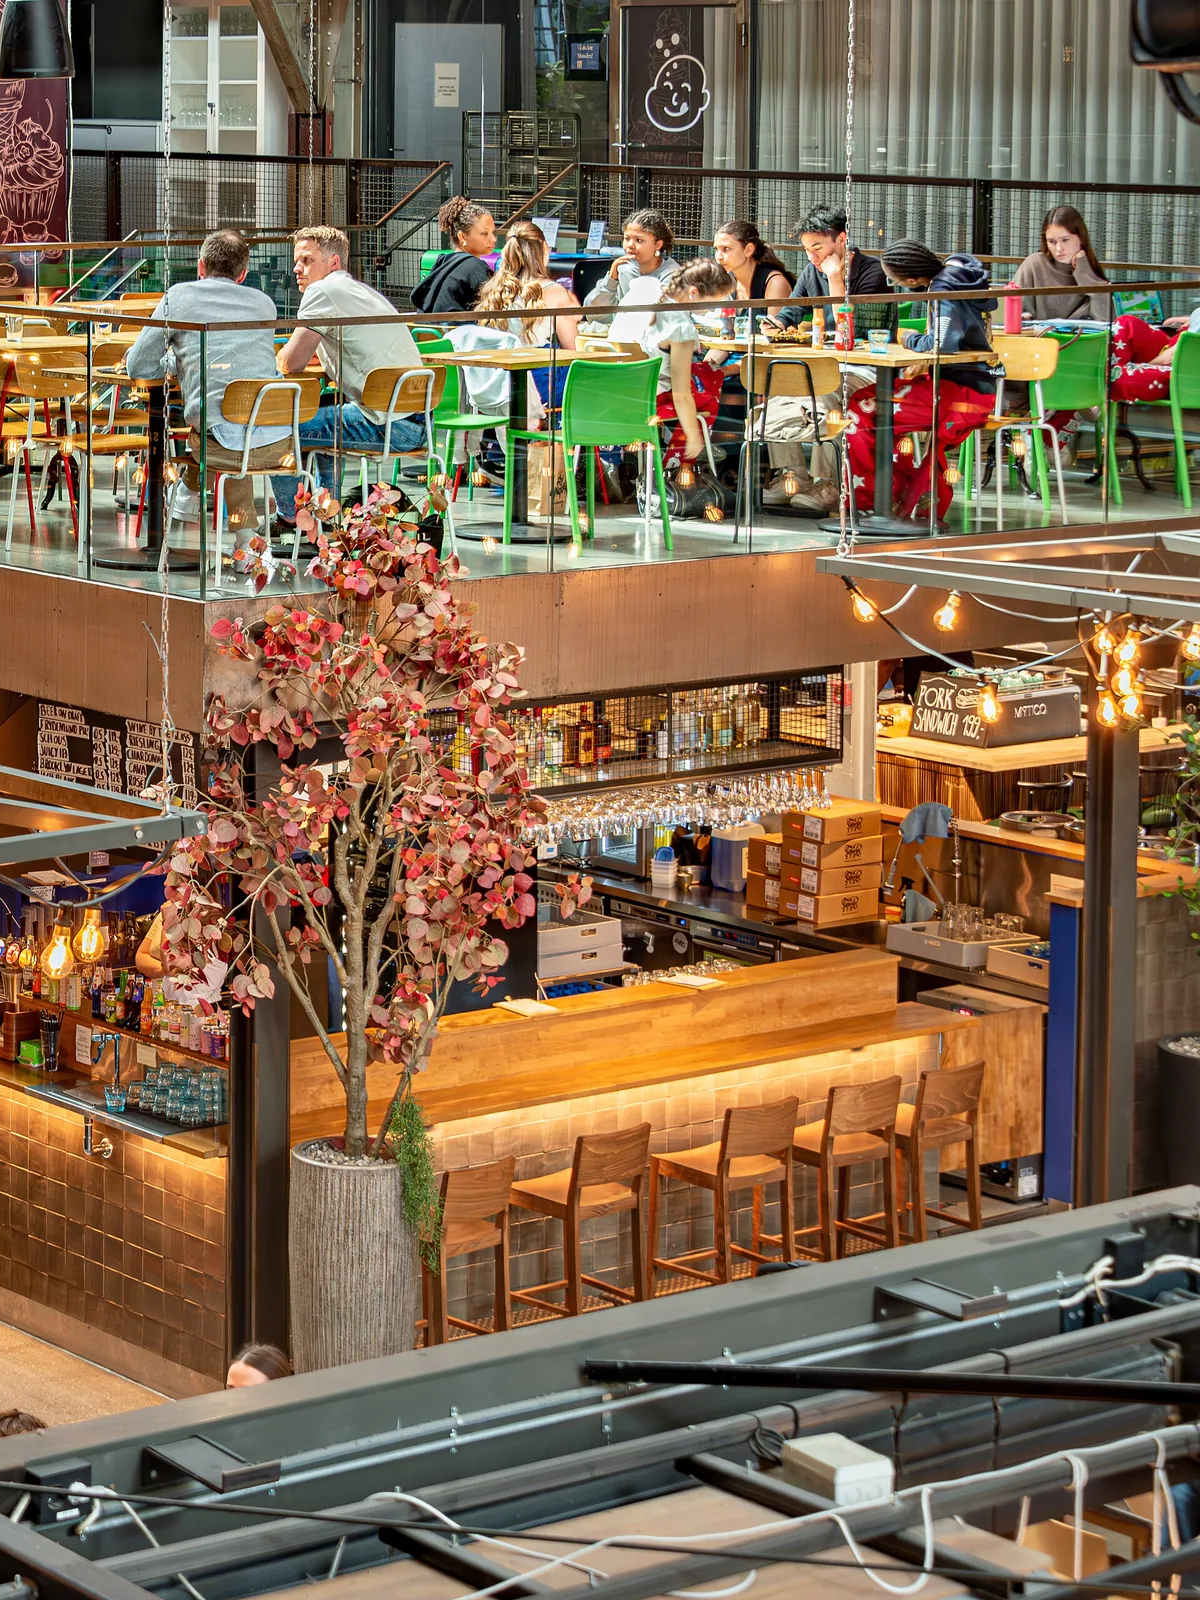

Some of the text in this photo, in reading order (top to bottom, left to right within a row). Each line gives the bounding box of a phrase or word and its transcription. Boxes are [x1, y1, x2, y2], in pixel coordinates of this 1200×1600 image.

[917, 685, 956, 710] PORK
[40, 705, 58, 717] BEER
[1014, 703, 1047, 718] MYTICO
[127, 721, 147, 734] WINE
[149, 727, 157, 737] BY
[913, 707, 960, 736] SANDWICH
[128, 734, 160, 750] RIESLING
[128, 763, 147, 776] CAVA
